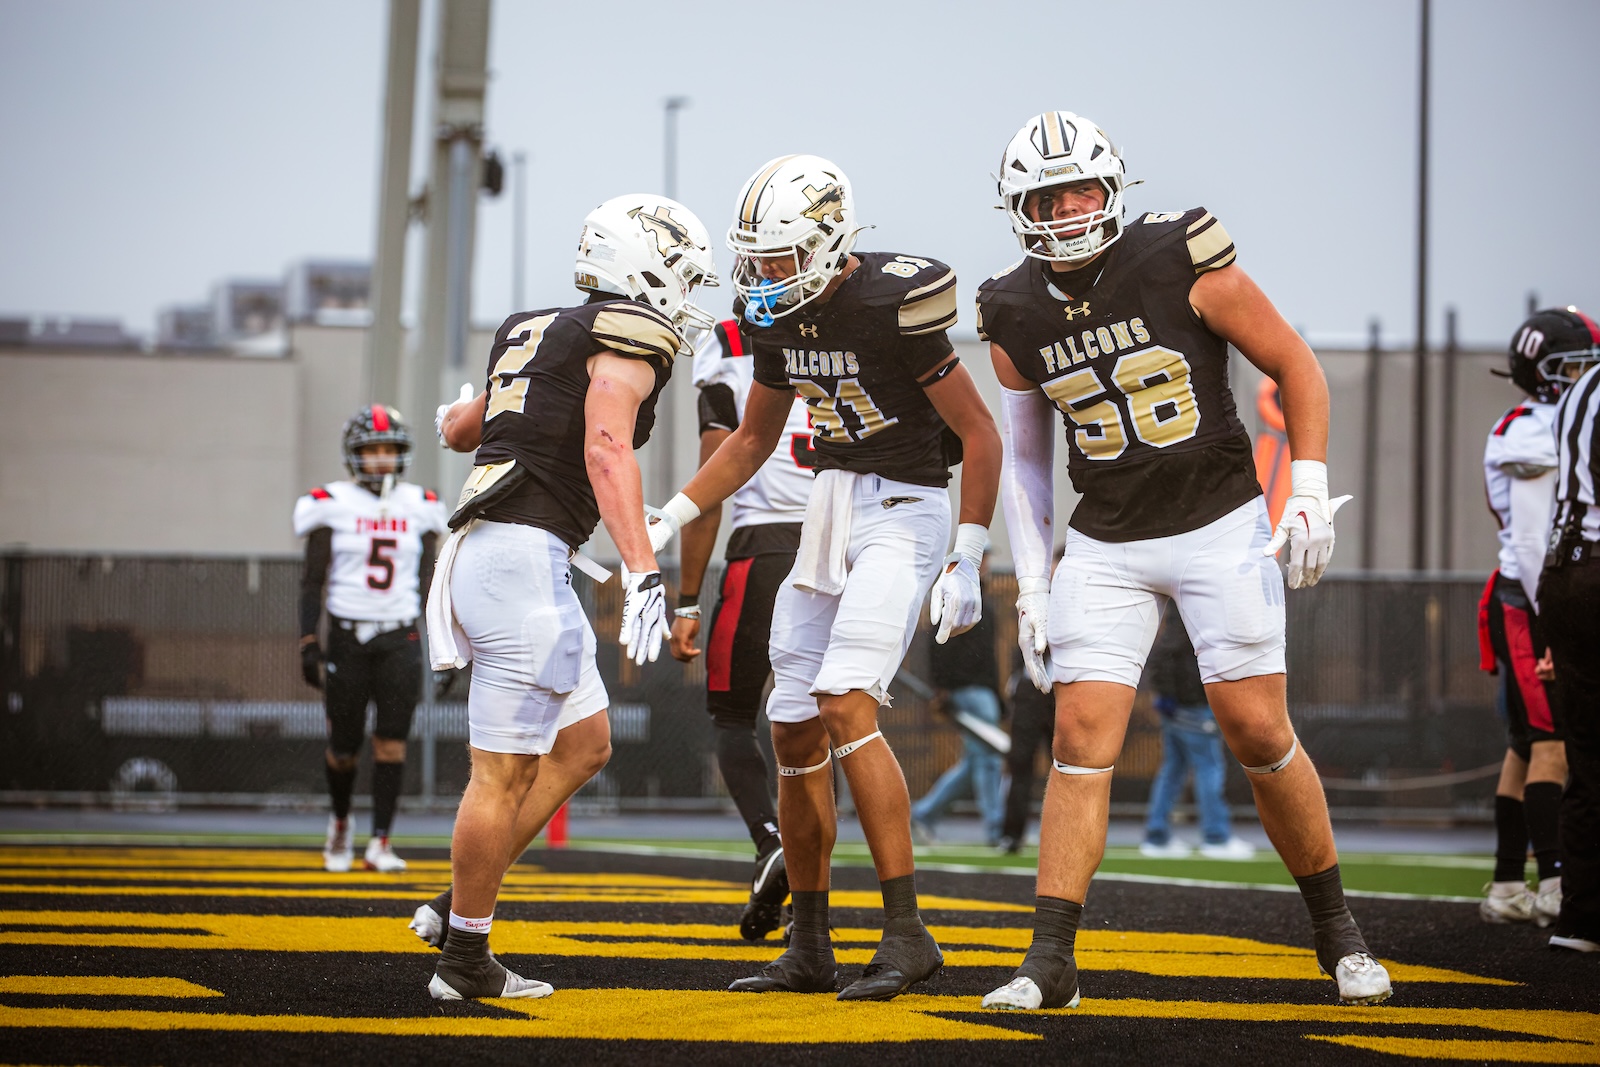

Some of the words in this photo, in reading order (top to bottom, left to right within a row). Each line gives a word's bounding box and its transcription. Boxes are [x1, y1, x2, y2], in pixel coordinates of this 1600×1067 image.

[1065, 238, 1088, 248] Riddell
[881, 255, 933, 278] 81
[1039, 317, 1151, 373] FALCONS
[1516, 326, 1545, 360] 10
[485, 312, 560, 422] 2
[784, 349, 860, 377] FALCONS
[1040, 345, 1201, 461] 58
[365, 537, 398, 592] 5
[1571, 545, 1583, 562] S
